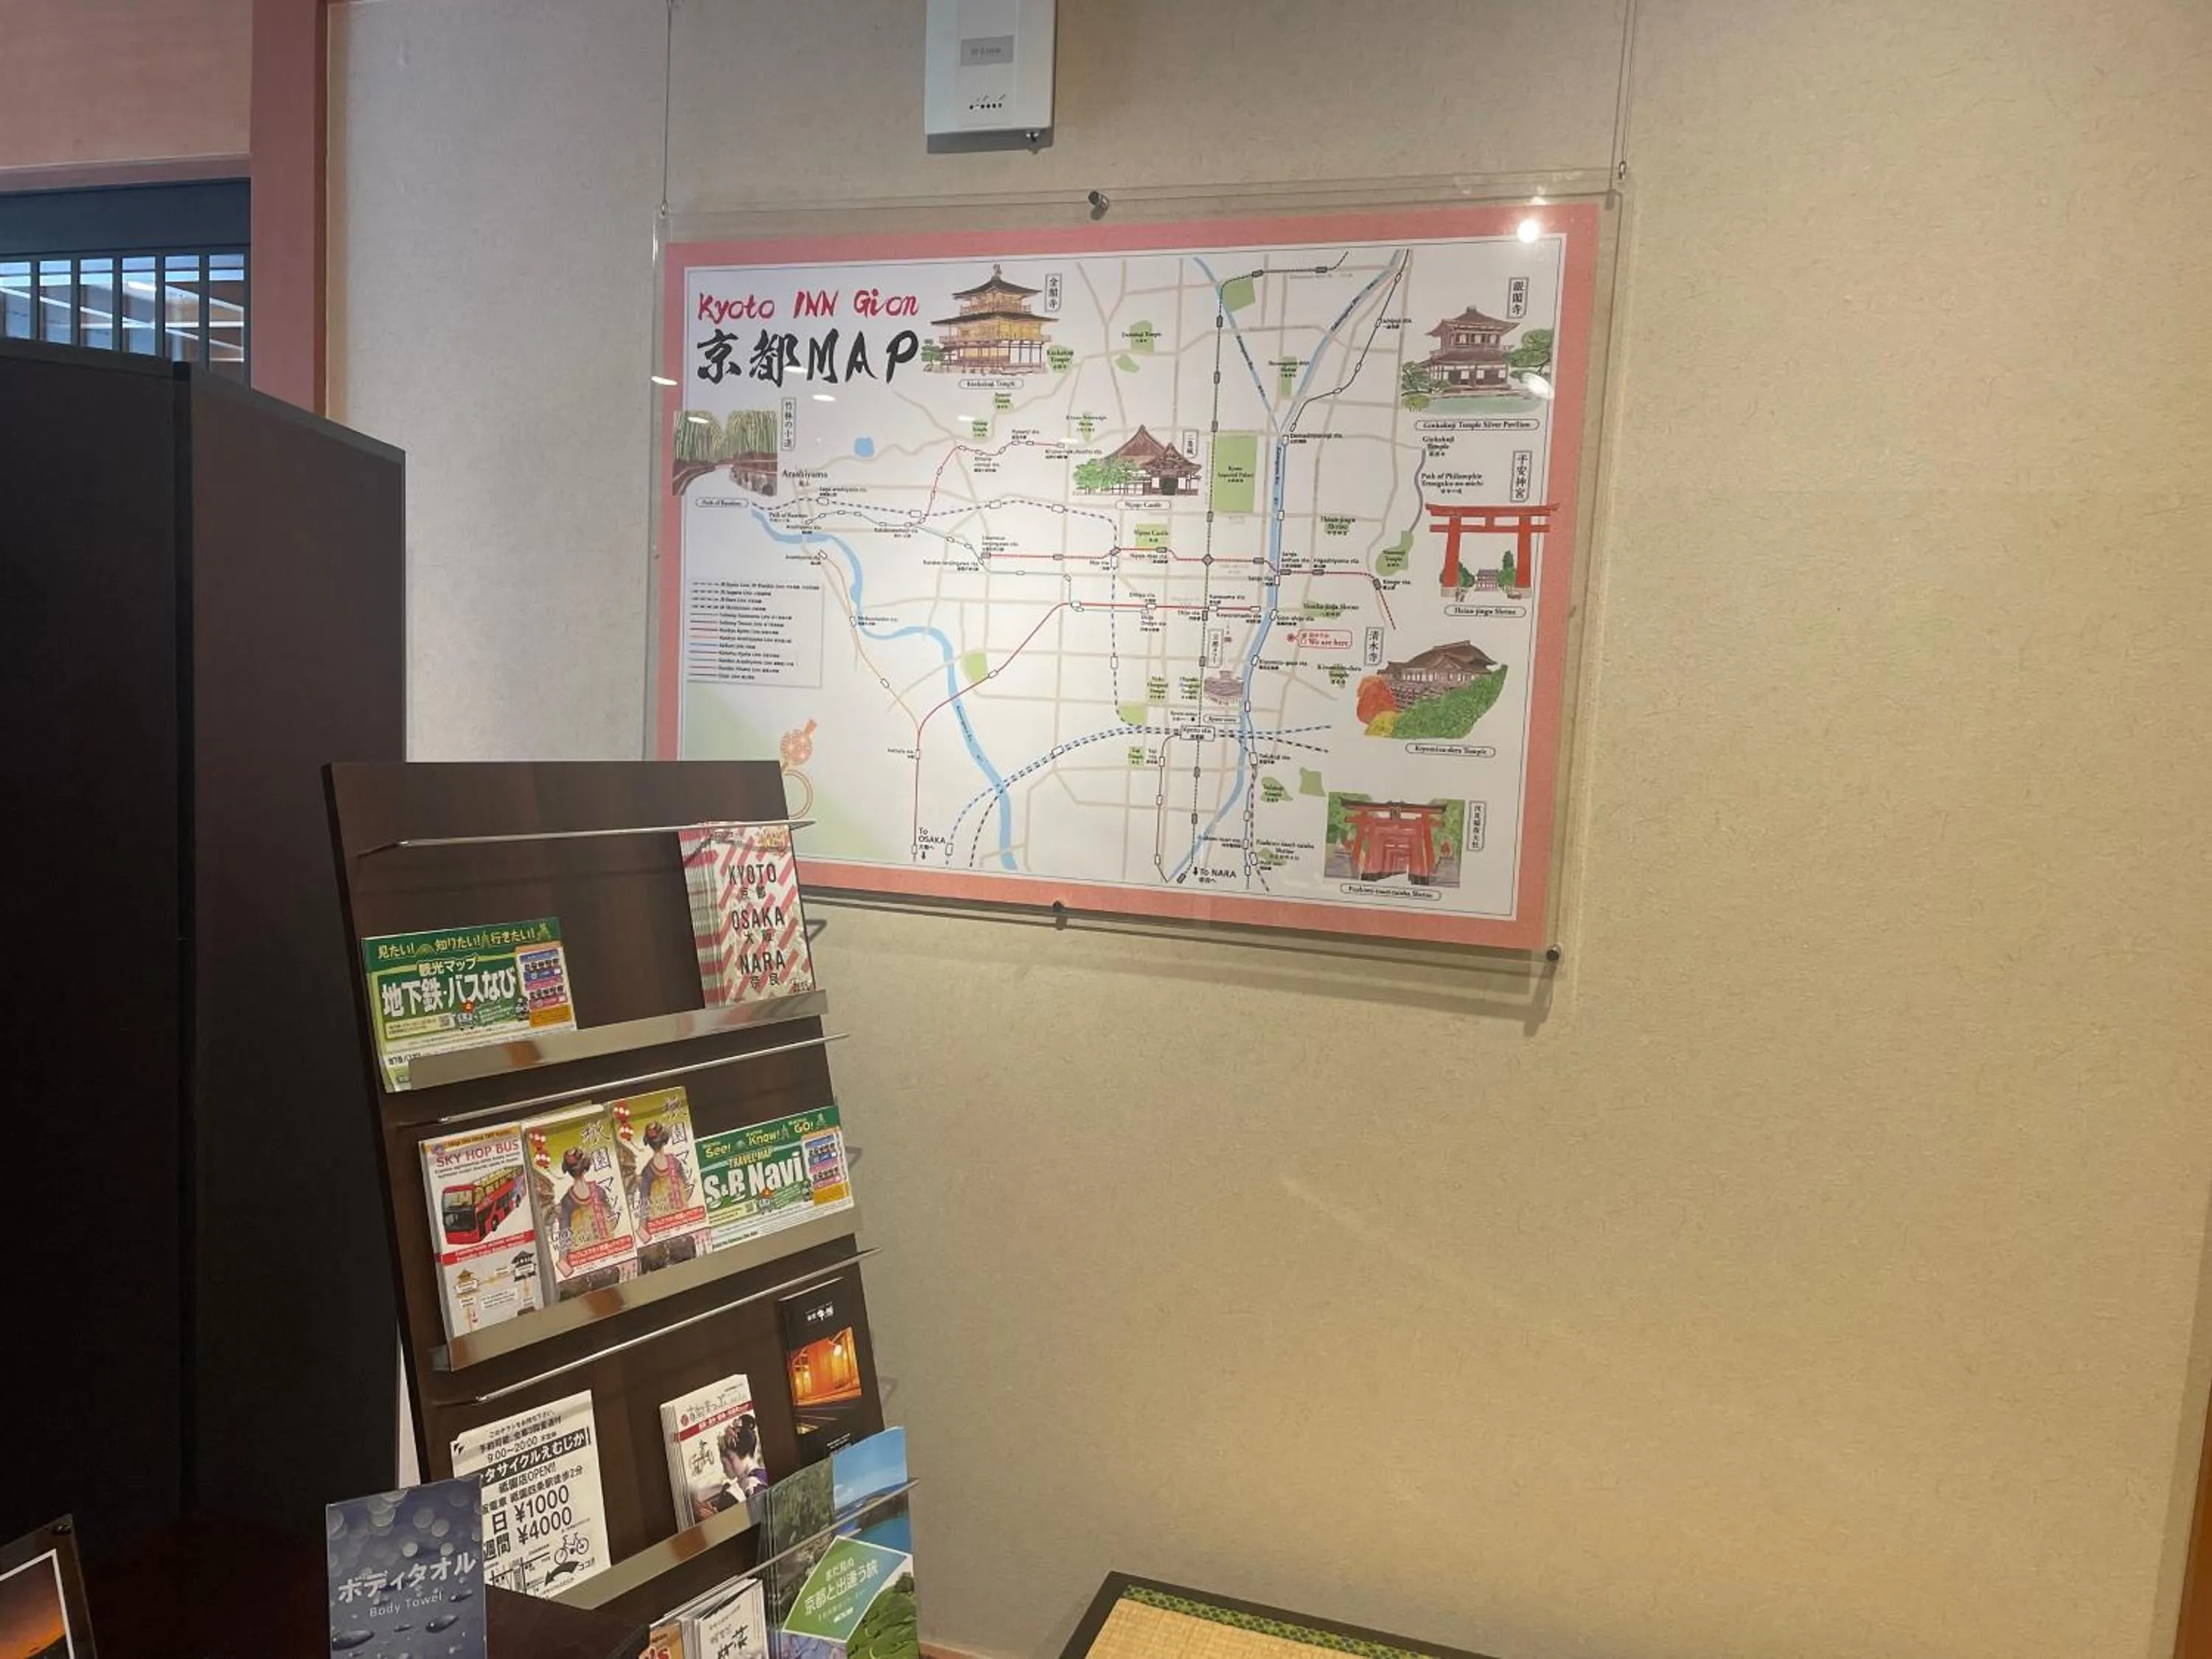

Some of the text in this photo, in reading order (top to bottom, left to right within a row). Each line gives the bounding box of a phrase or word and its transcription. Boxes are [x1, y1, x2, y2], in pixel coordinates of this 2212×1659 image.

[698, 288, 919, 324] Kyoto INN Gion
[918, 835, 946, 844] OSAKA
[728, 863, 777, 885] KYOTO
[1211, 869, 1237, 878] NARA
[731, 906, 785, 931] OSAKA
[740, 950, 787, 975] NARA
[748, 1130, 781, 1147] Know!
[435, 1152, 462, 1168] SKY
[465, 1146, 493, 1162] HOP
[495, 1141, 521, 1156] BUS
[747, 1151, 805, 1196] Navi
[484, 1433, 585, 1483] タサイクルえむじか
[514, 1484, 569, 1523] ¥1000
[517, 1506, 572, 1545] ¥4000
[338, 1551, 477, 1604] ボディタオル
[369, 1590, 442, 1617] Body Towel
